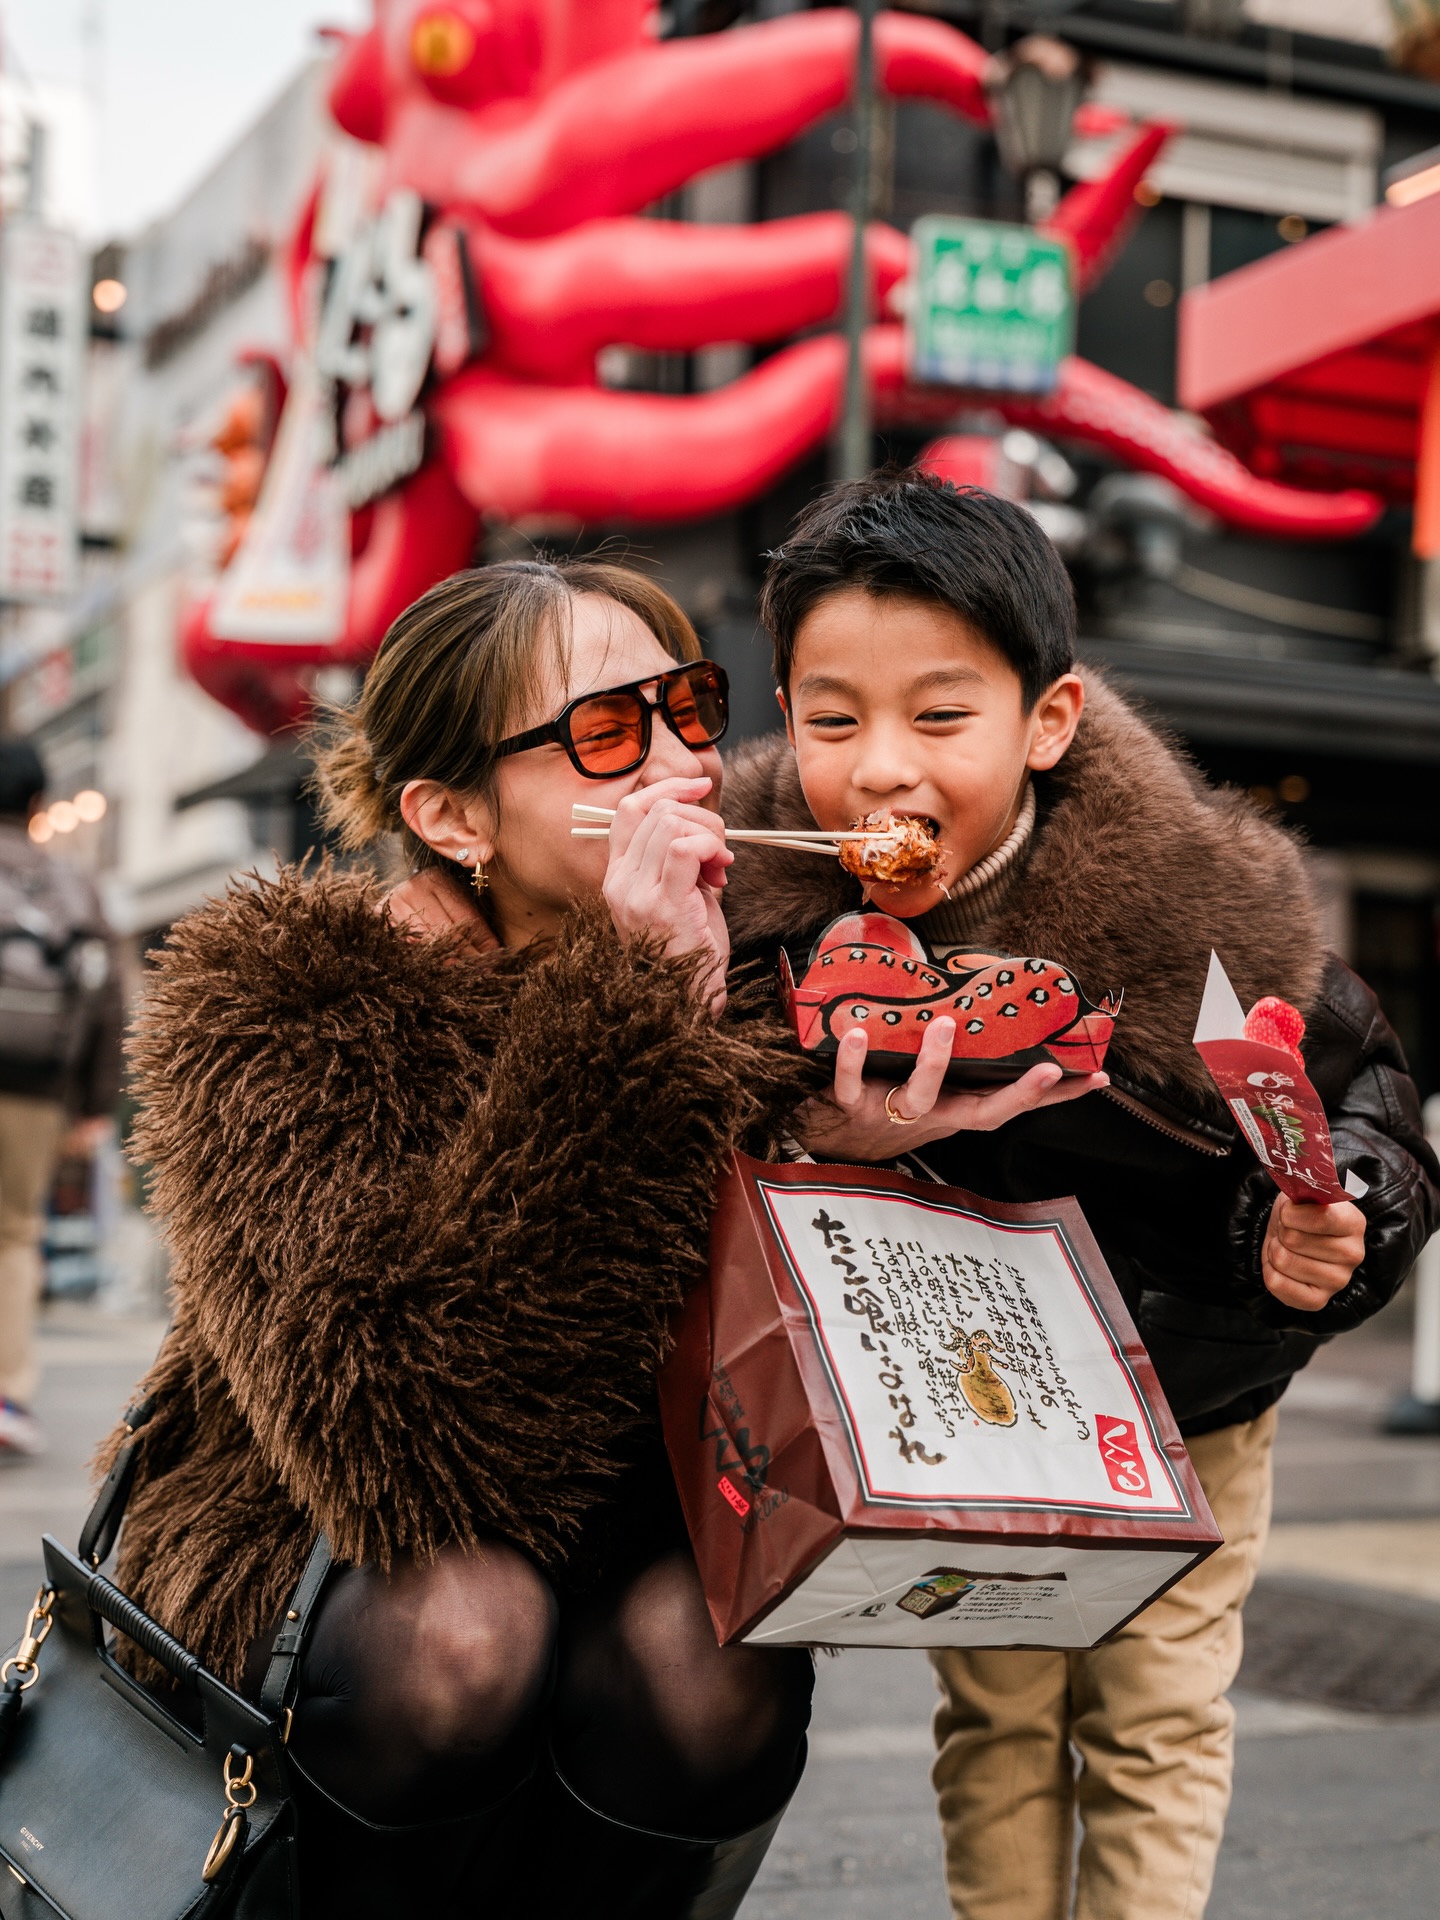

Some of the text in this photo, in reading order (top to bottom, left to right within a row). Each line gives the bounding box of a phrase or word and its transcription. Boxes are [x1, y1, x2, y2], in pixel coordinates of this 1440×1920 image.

[944, 1252, 981, 1303] たこ
[810, 1208, 946, 1465] たこ喰いなはれ
[1103, 1424, 1147, 1491] くくる
[20, 1827, 45, 1851] GIVENCHY
